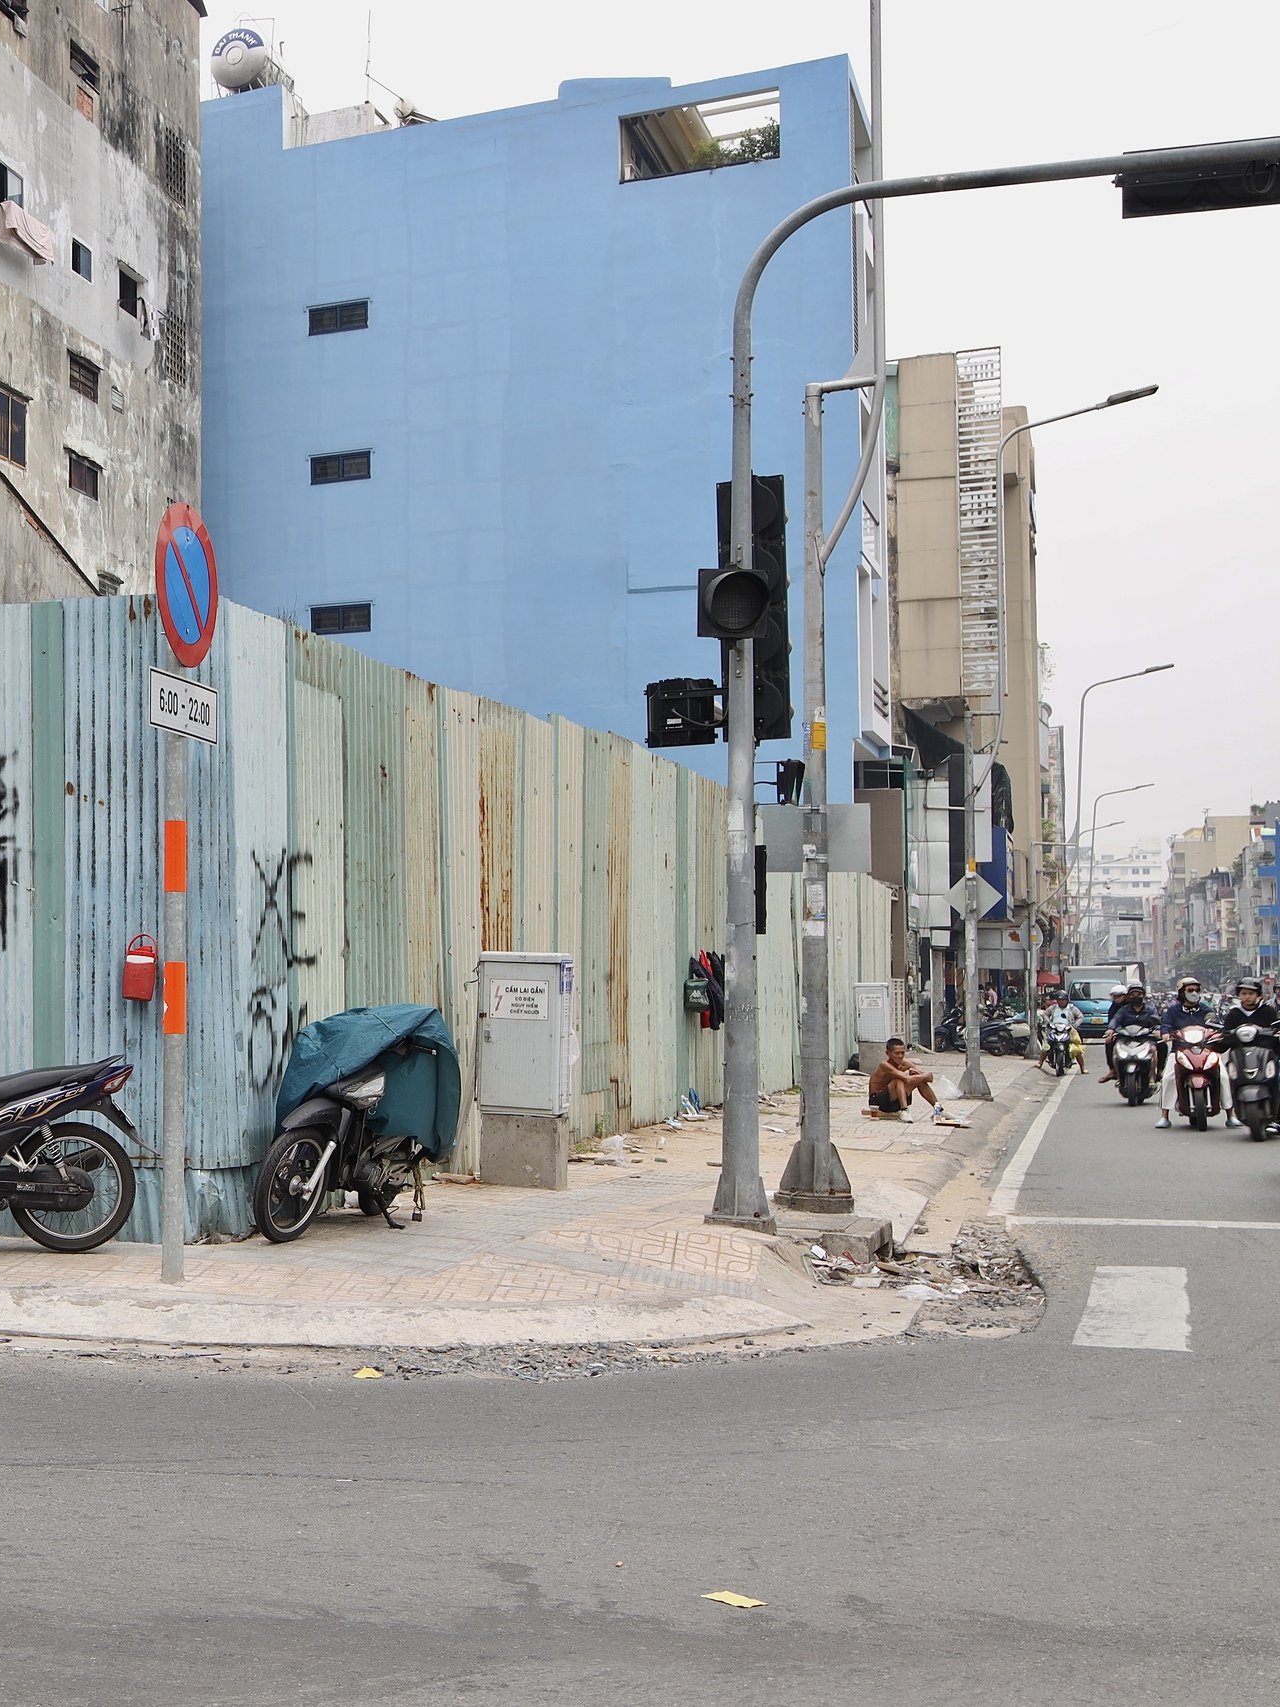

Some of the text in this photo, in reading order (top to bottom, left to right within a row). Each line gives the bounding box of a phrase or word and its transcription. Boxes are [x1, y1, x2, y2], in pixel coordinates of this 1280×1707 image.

[159, 687, 179, 716] 6:00
[188, 697, 211, 727] 22:00
[251, 847, 317, 969] XE
